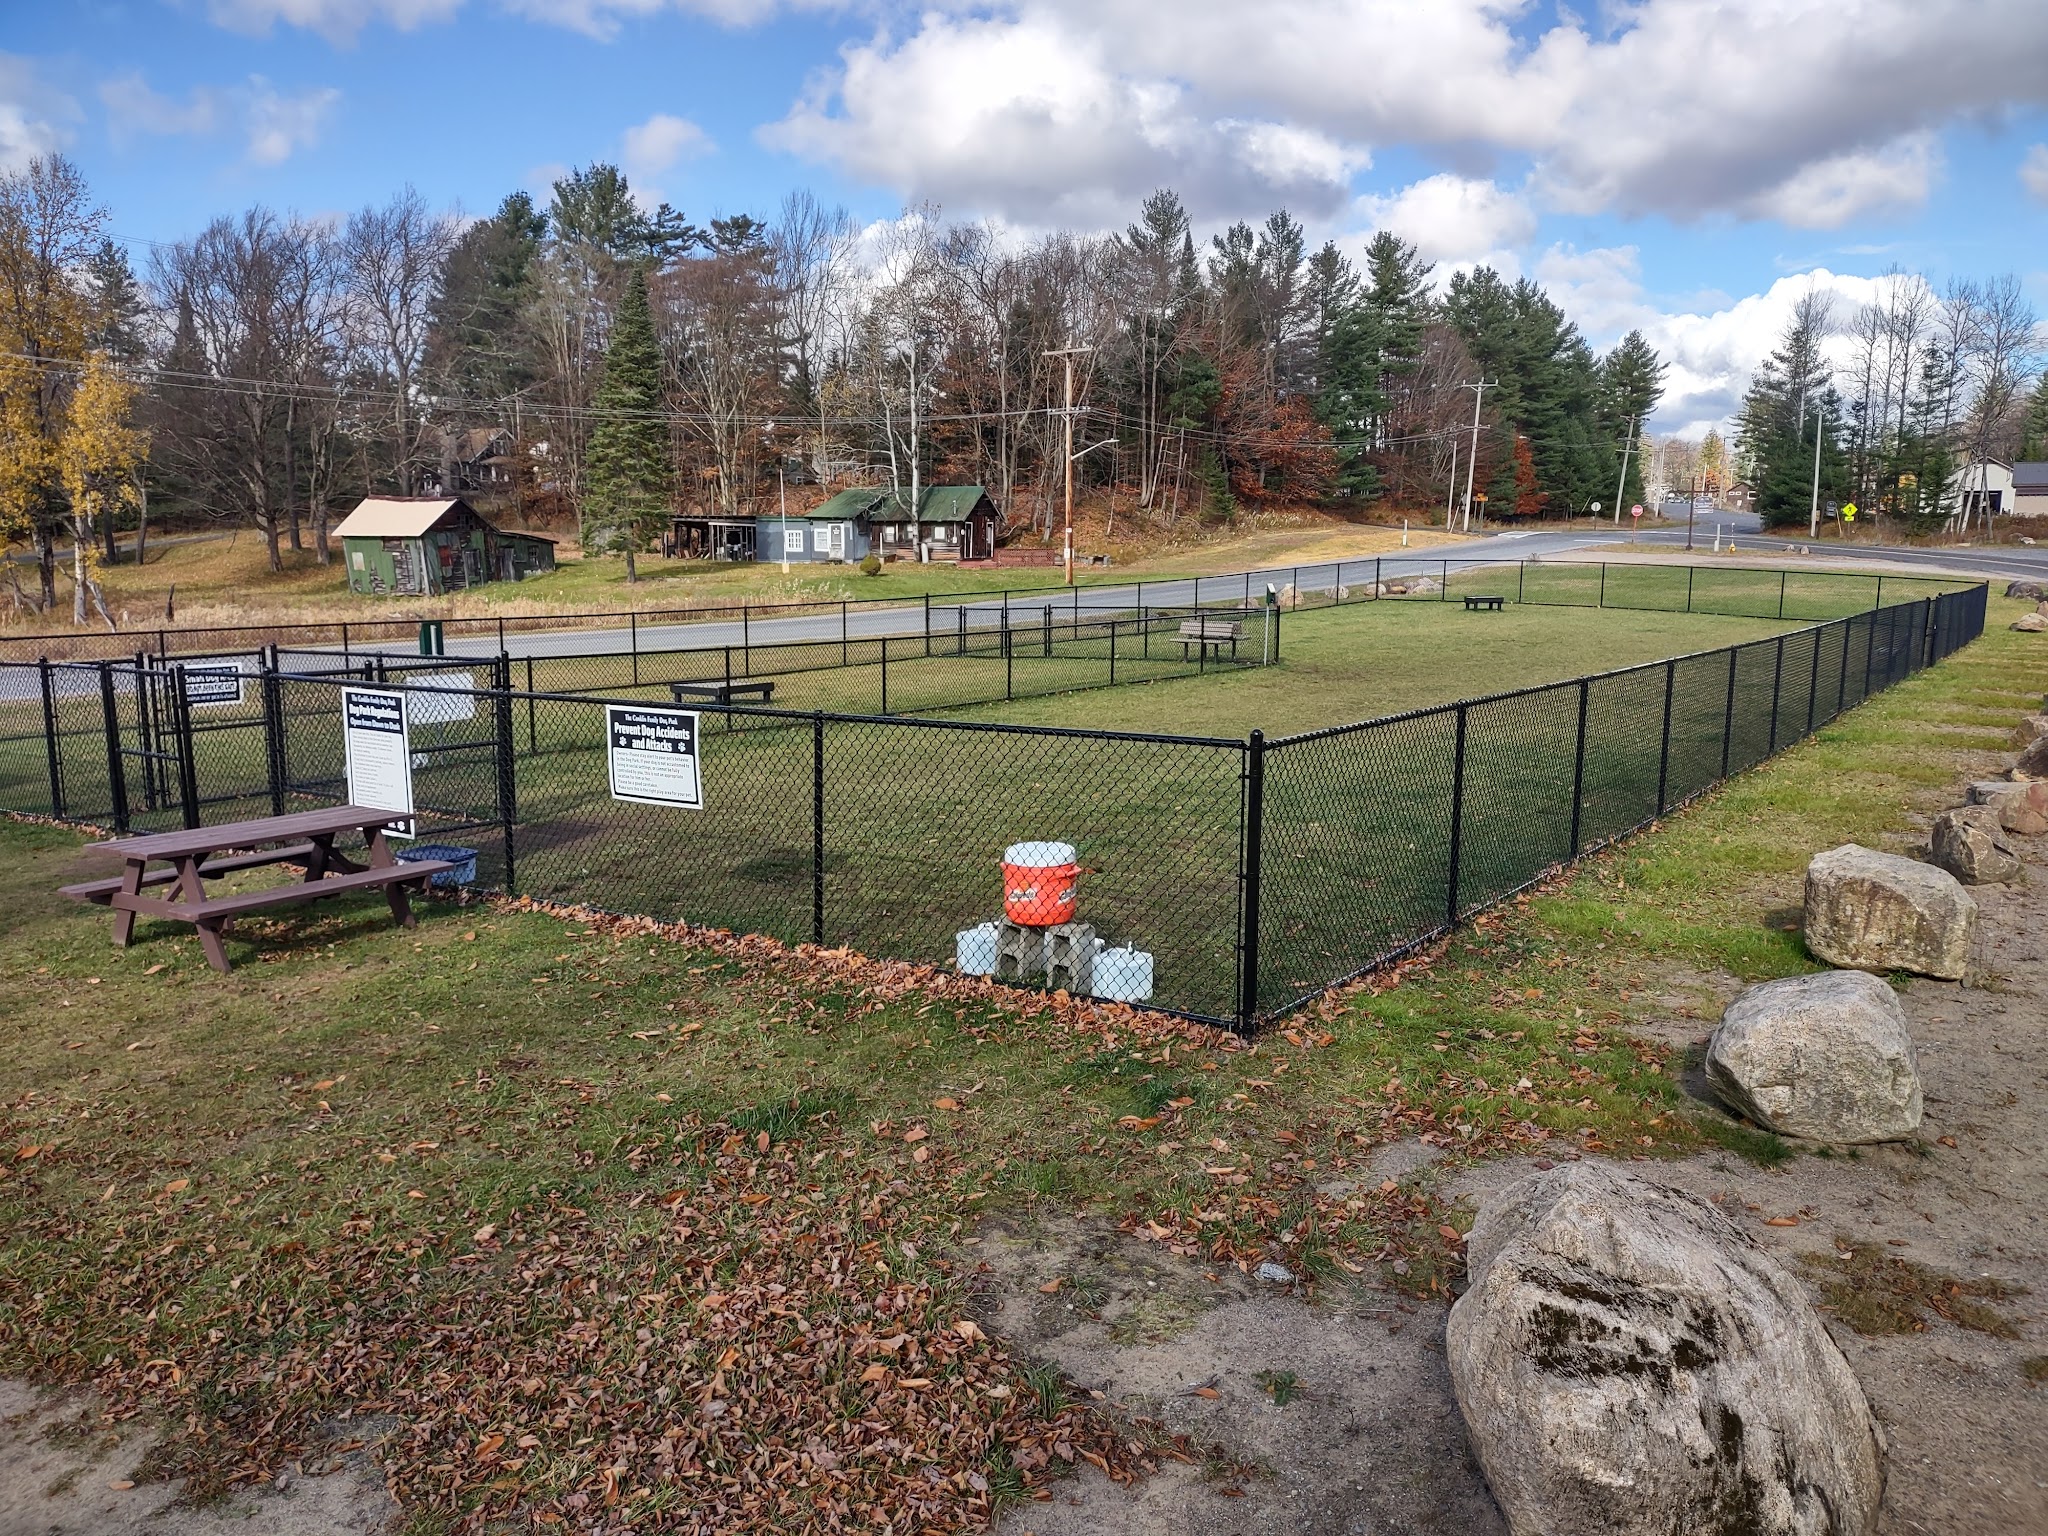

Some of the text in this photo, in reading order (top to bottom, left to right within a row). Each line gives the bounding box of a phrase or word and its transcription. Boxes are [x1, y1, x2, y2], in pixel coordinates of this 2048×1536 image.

[185, 675, 205, 683] Small
[380, 697, 388, 706] Dog
[349, 704, 399, 719] Dog Park Regulations
[350, 717, 361, 727] Open
[362, 718, 371, 727] from
[372, 720, 384, 728] Dawn
[389, 722, 400, 730] Dusk
[647, 716, 658, 724] Family
[659, 717, 668, 725] Dog
[668, 717, 678, 725] Park
[614, 722, 690, 740] Prevent Dog Accidents
[631, 737, 672, 752] and Attacks
